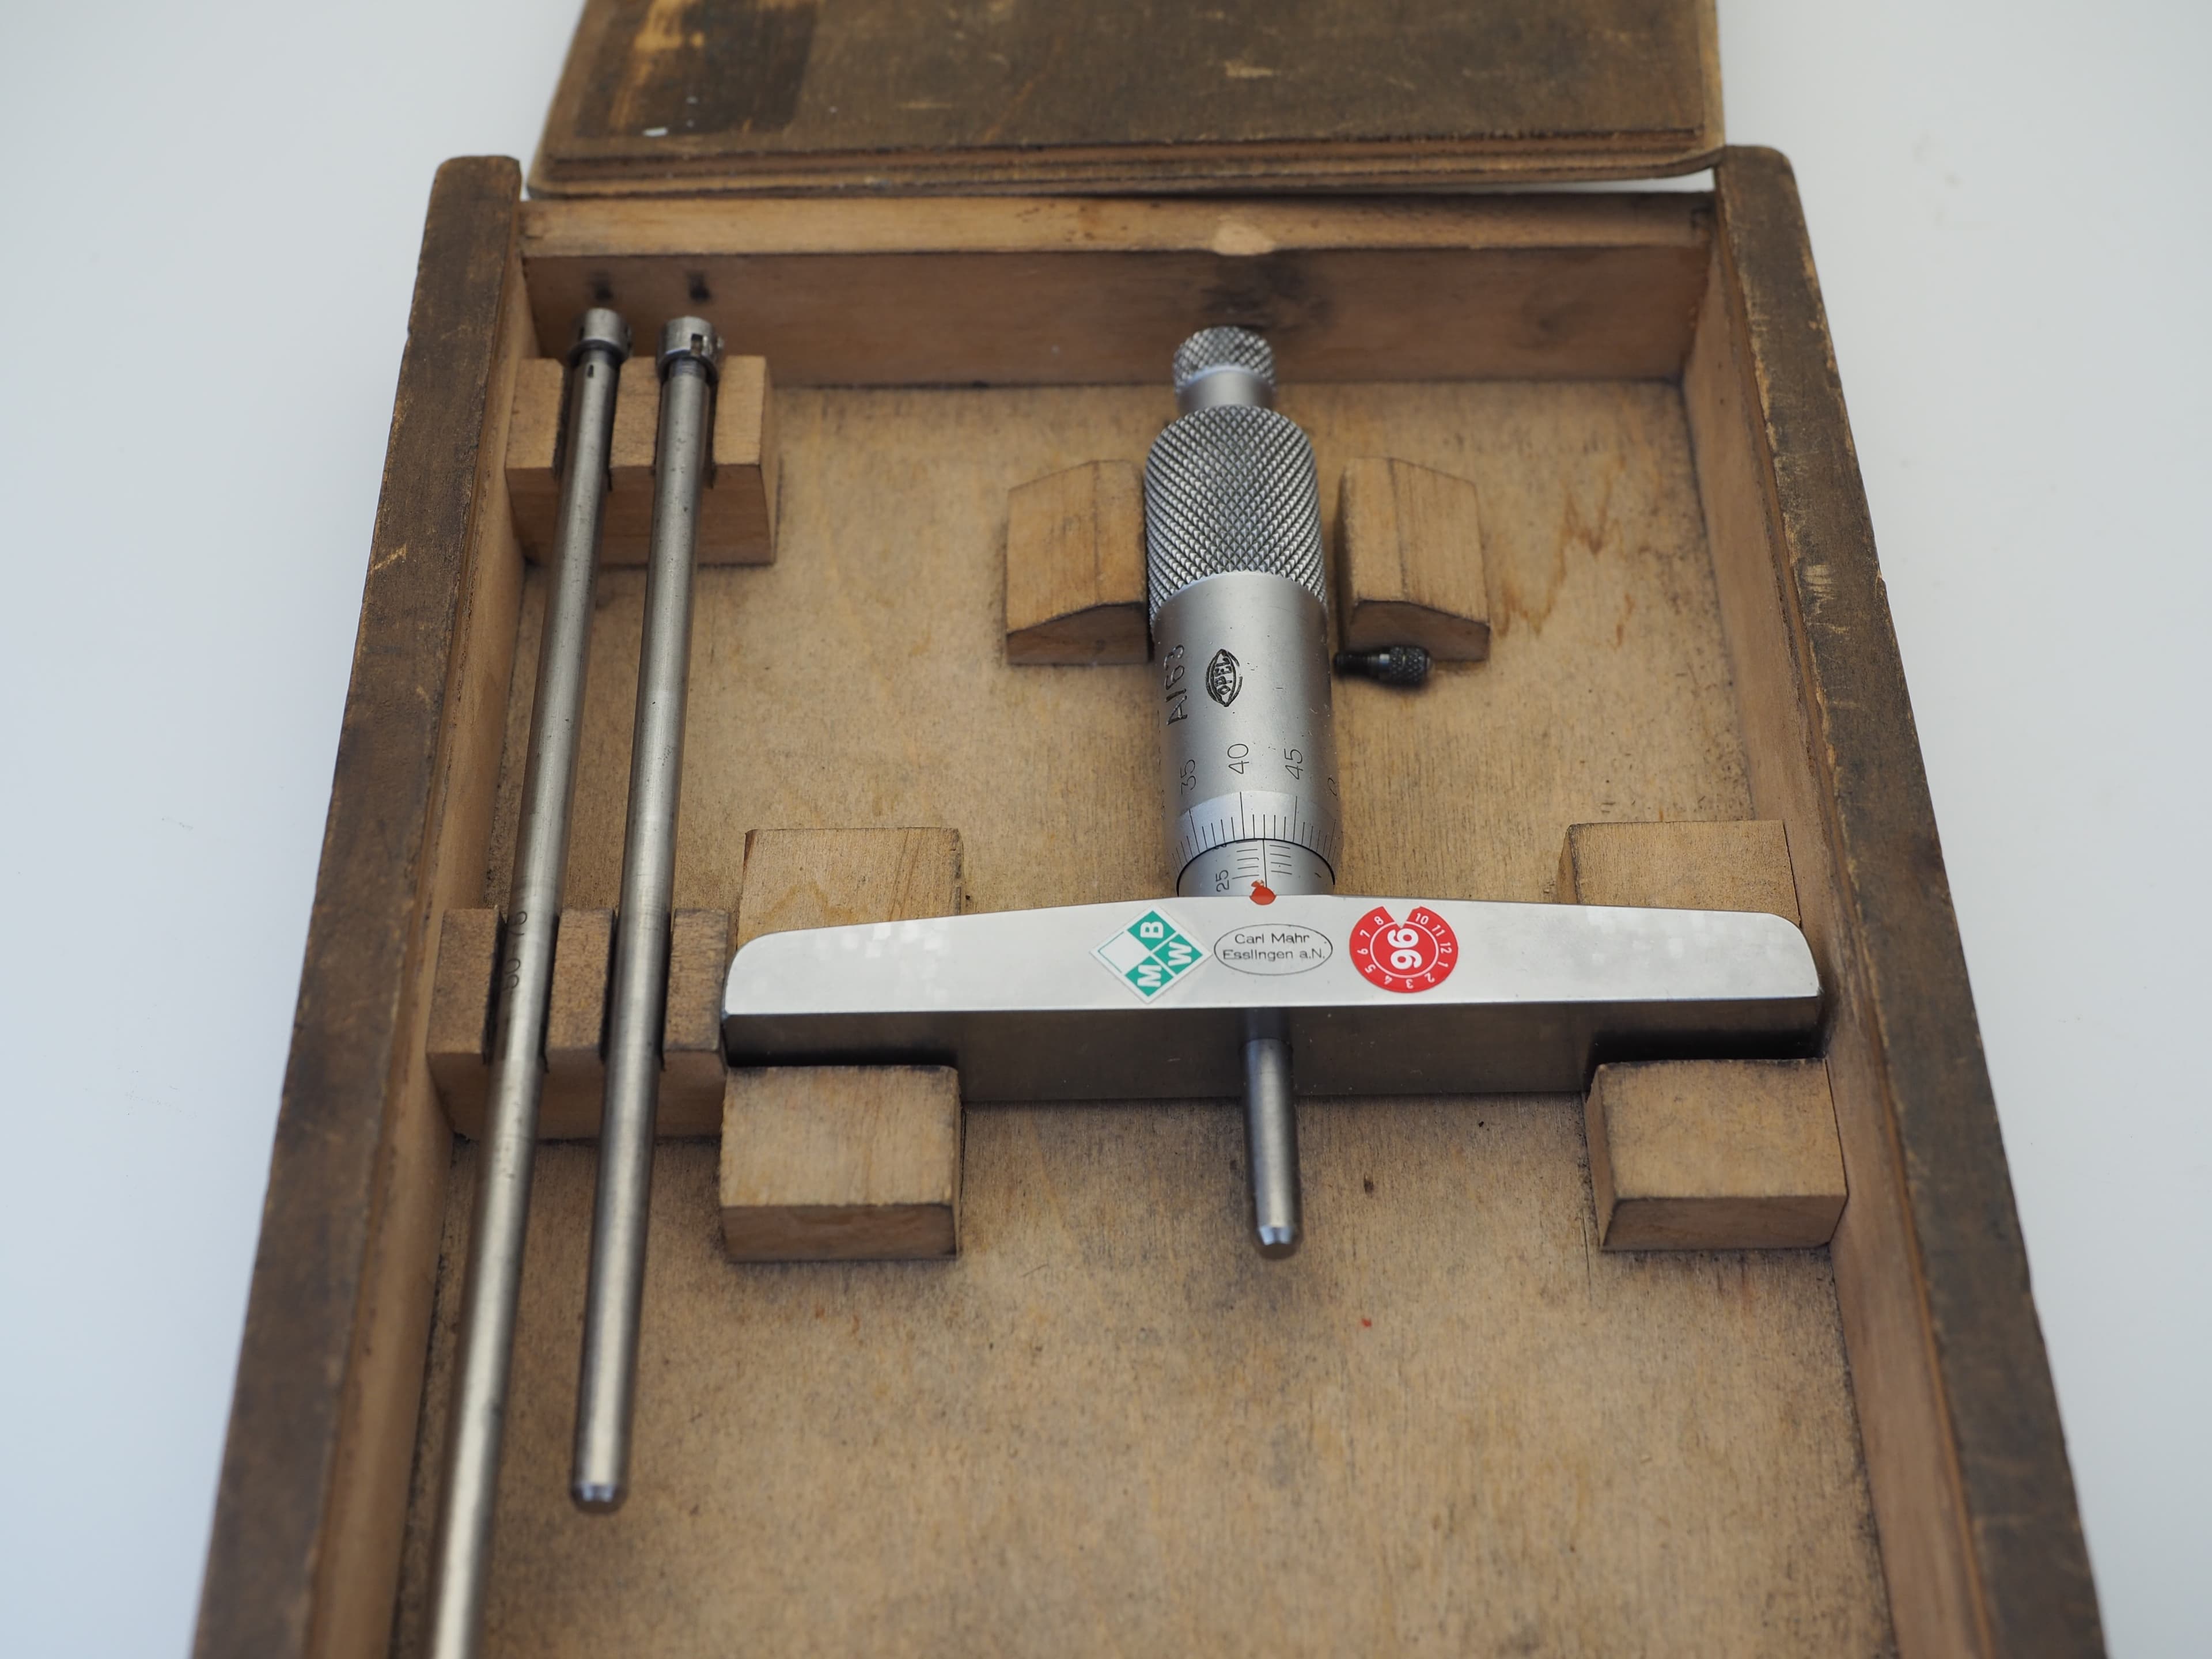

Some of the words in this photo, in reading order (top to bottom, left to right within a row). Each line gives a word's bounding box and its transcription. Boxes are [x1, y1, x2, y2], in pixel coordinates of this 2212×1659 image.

[1213, 657, 1233, 695] OPEL
[1227, 743, 1249, 774] 40
[1284, 748, 1304, 779] 45
[1180, 759, 1196, 795] 35
[1215, 869, 1230, 892] 25
[1374, 916, 1384, 925] 8
[1415, 912, 1429, 925] 10
[1359, 929, 1370, 938] 7
[1431, 925, 1445, 937] 11
[1234, 933, 1264, 944] Carl
[1271, 933, 1309, 944] Mahr
[1387, 928, 1422, 970] 96
[1440, 942, 1452, 954] 12
[1222, 949, 1293, 962] Esslingen
[1299, 948, 1325, 959] a.N.
[1365, 964, 1377, 974] 5
[1384, 975, 1393, 985] 4
[1424, 972, 1435, 983] 2
[1406, 979, 1414, 989] 3
